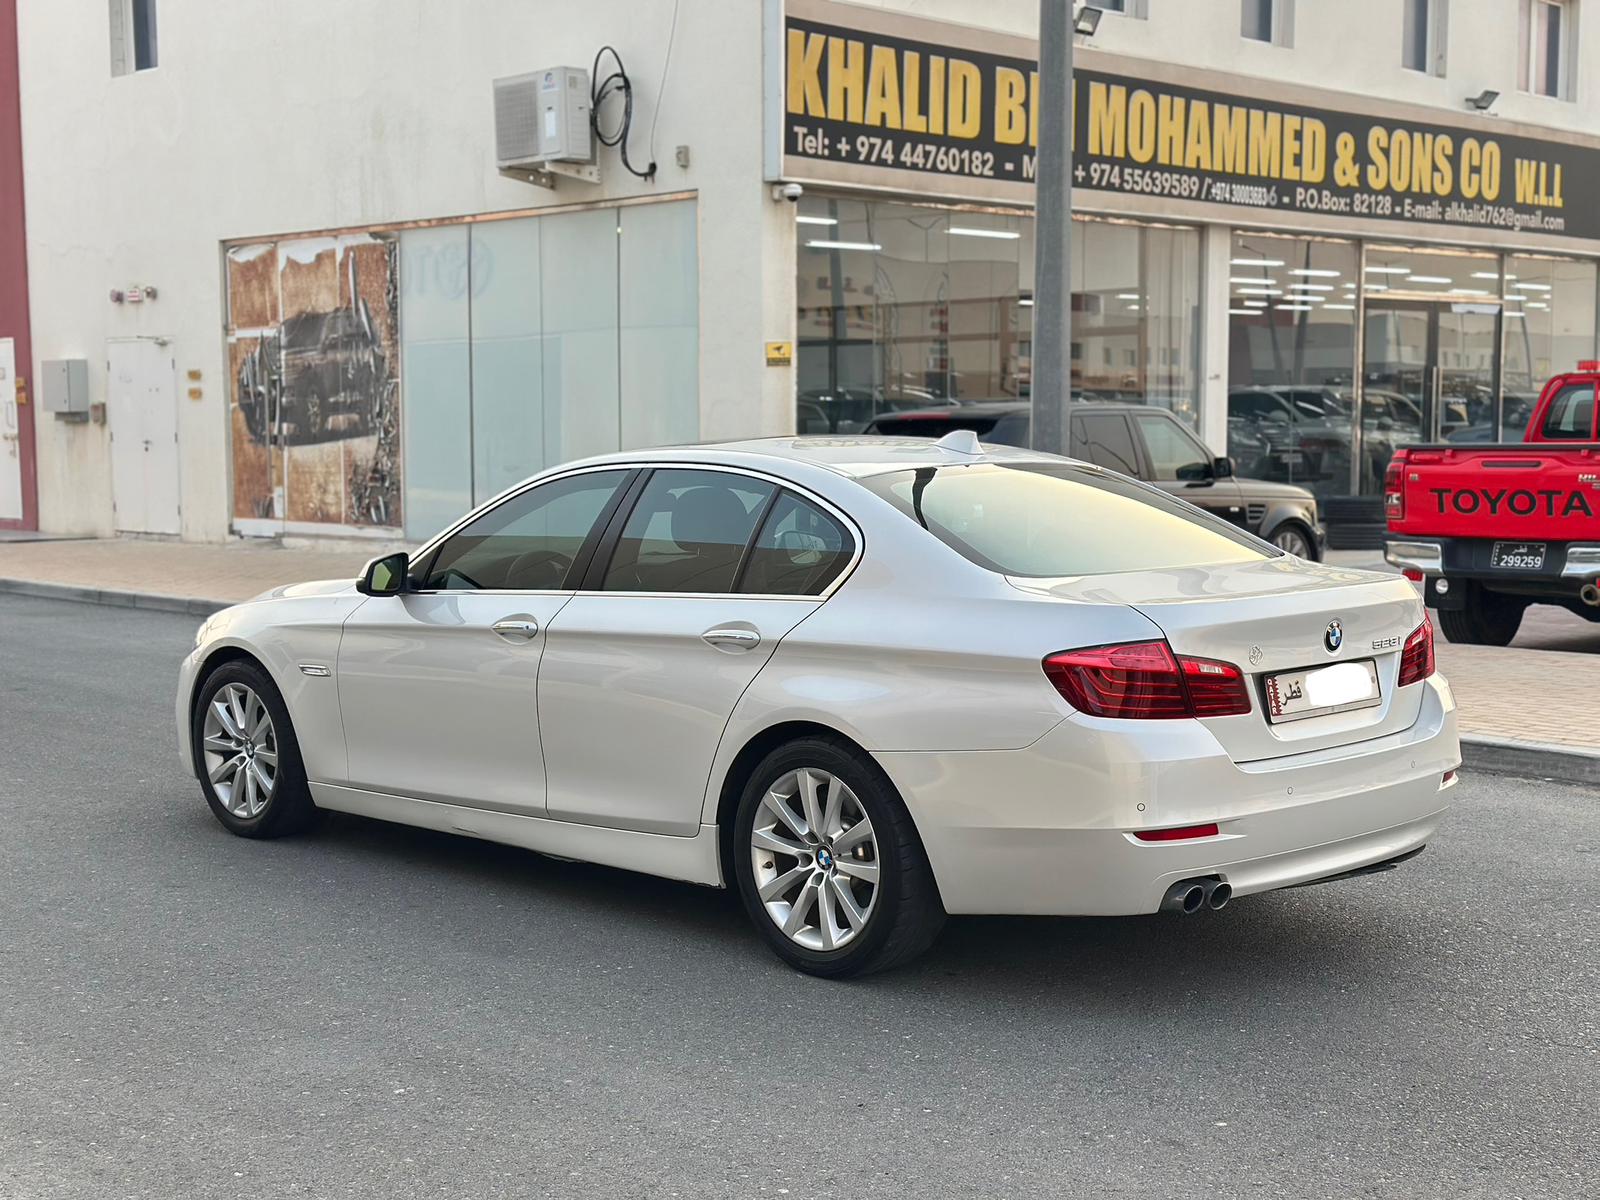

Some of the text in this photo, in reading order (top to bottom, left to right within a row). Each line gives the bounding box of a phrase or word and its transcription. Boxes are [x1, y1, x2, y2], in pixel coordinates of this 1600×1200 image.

[787, 28, 981, 139] KHALID
[994, 66, 1076, 152] BI
[1088, 81, 1327, 184] MOHAMMED
[1333, 132, 1360, 187] &
[1367, 126, 1454, 197] SONS
[1460, 137, 1501, 201] CO
[793, 126, 829, 156] Tel:
[856, 135, 894, 165] 974
[900, 142, 994, 177] 44760182
[1090, 162, 1120, 188] 974
[1123, 168, 1200, 198] 55639589
[1296, 187, 1350, 211] P.O.Box:
[1353, 193, 1392, 215] 82128
[1404, 198, 1442, 219] E-mail:
[1444, 201, 1565, 231] alkhalid762@gmail.com
[1430, 488, 1593, 518] TOYOTA
[1500, 555, 1541, 568] 299259
[1267, 678, 1277, 714] QATAR
[1281, 680, 1302, 706] قطر
